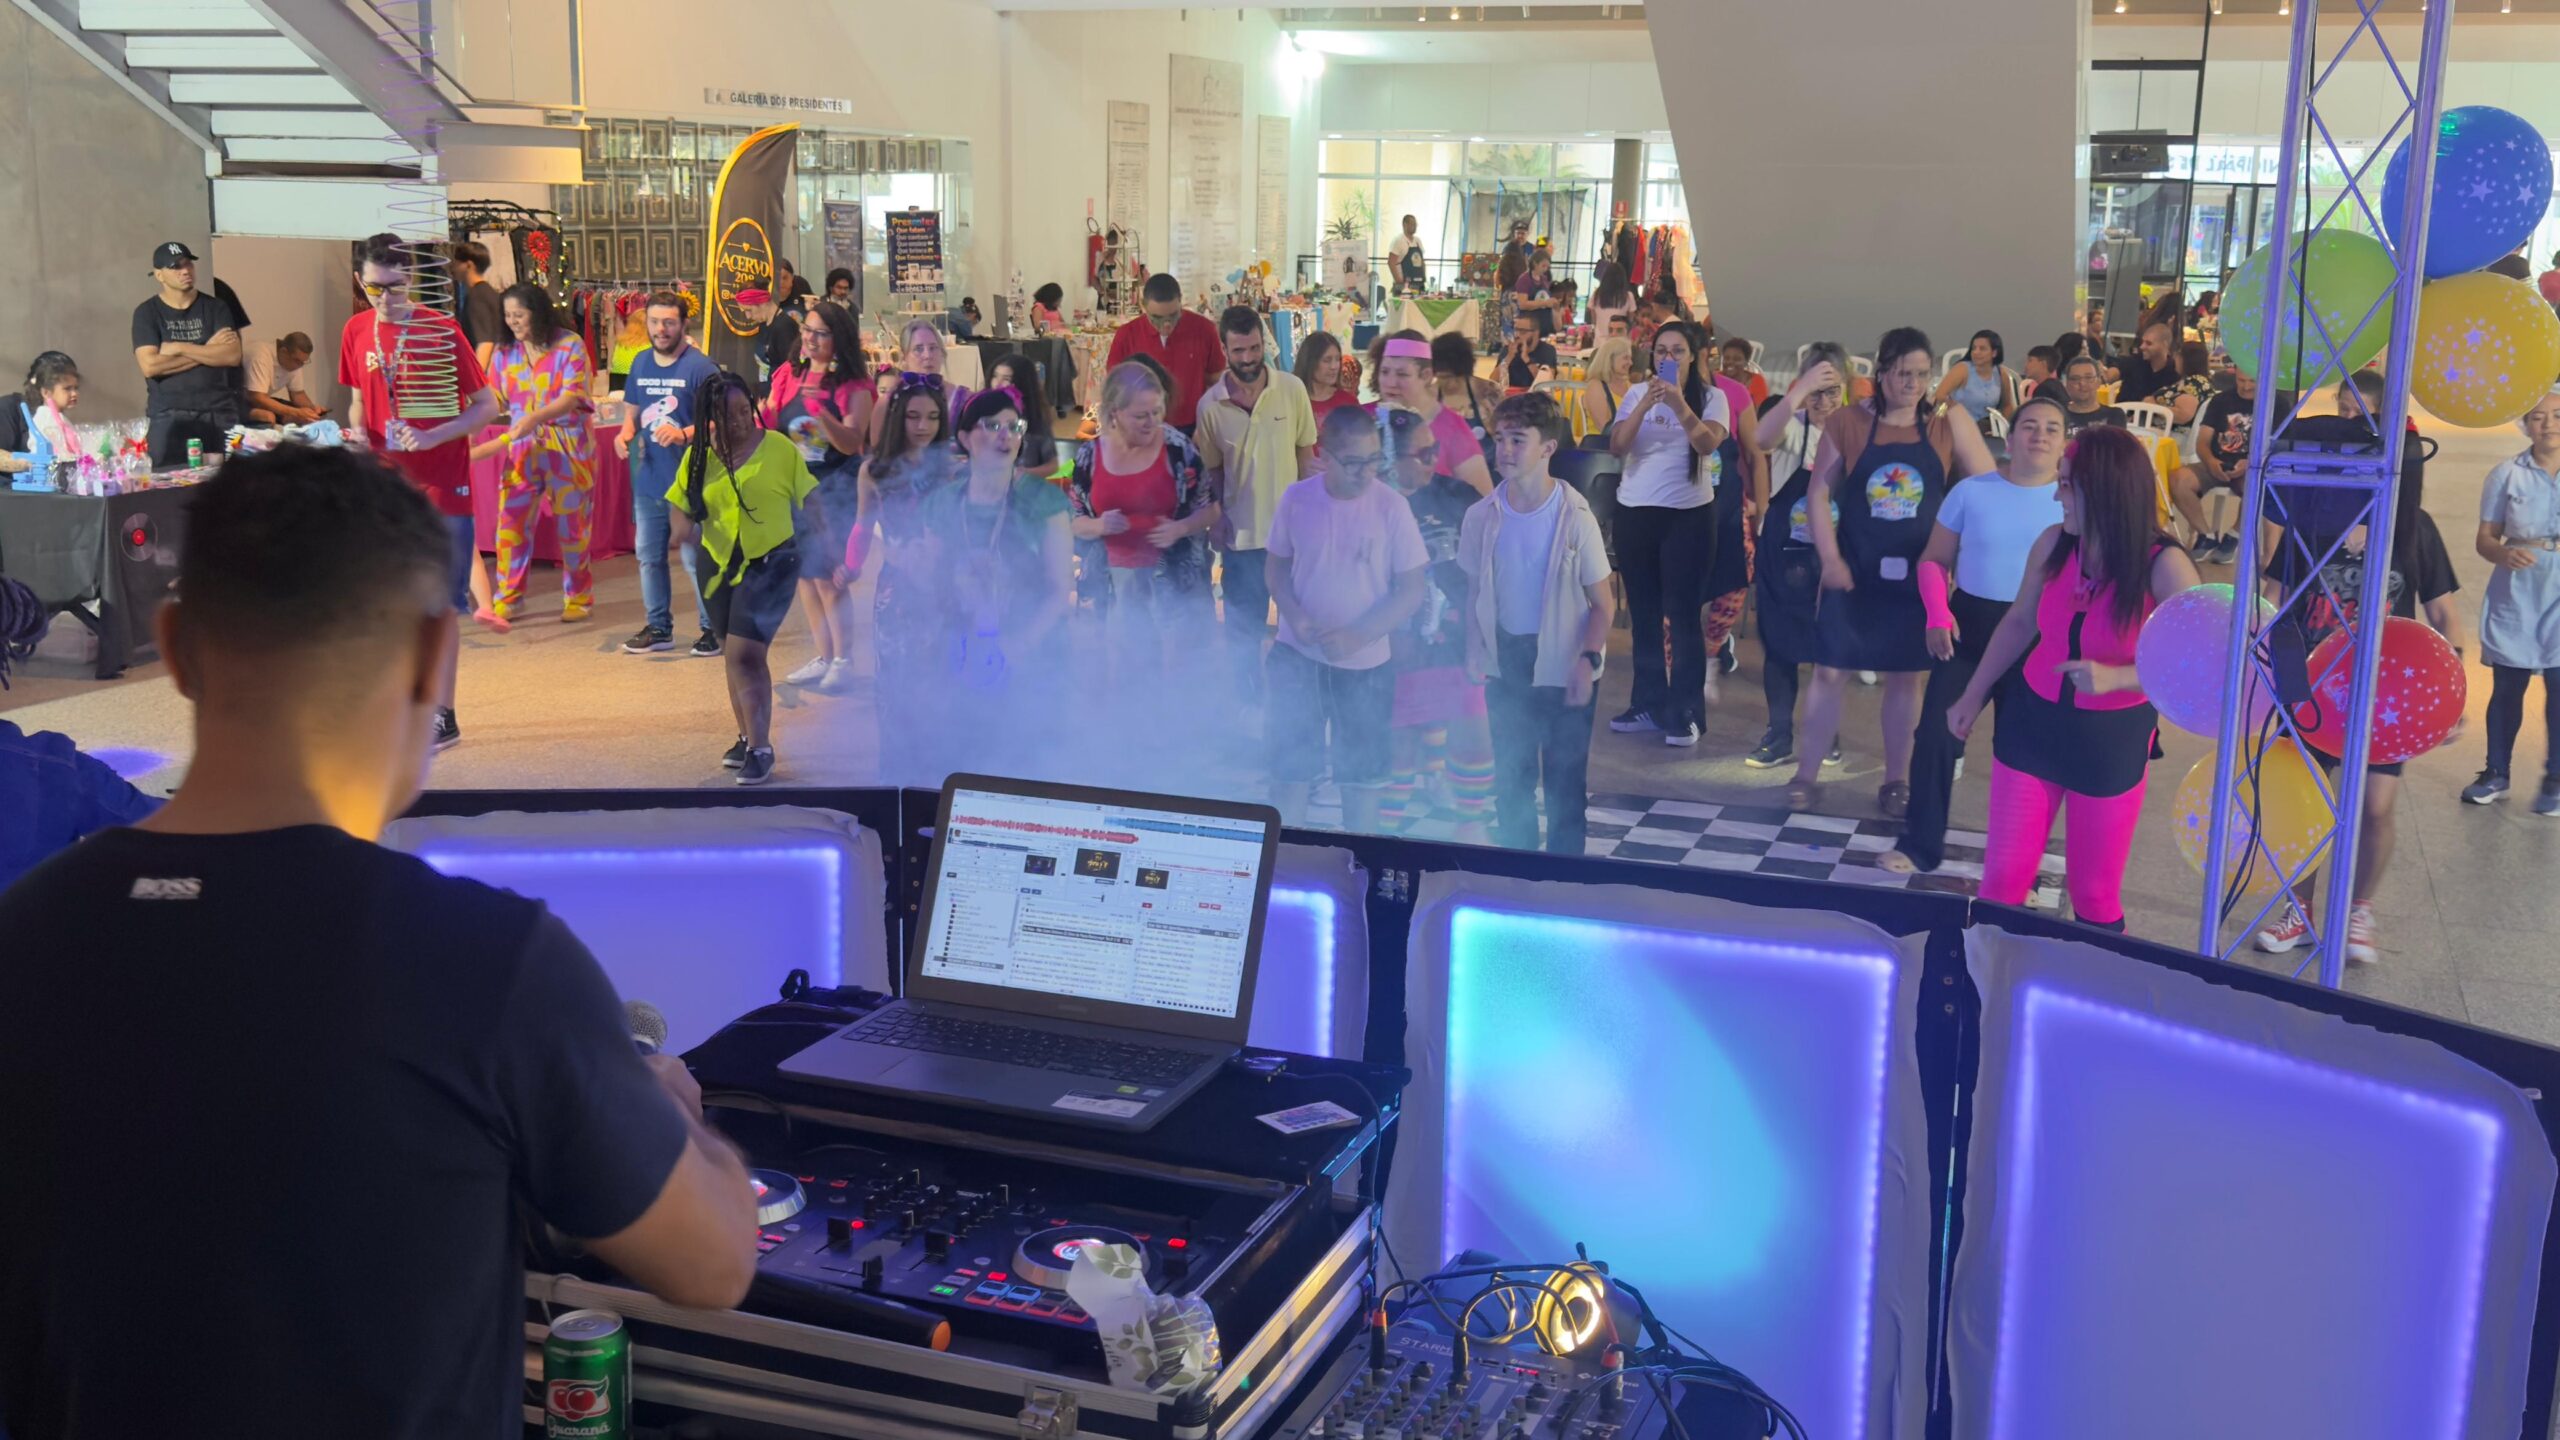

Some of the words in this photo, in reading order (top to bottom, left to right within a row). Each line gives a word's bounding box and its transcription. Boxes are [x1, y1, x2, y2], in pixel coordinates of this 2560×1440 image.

[730, 92, 768, 106] GALERIA
[770, 96, 786, 107] DOS
[789, 98, 843, 111] PRESIDENTES
[891, 217, 935, 226] Presentes
[719, 252, 770, 278] ACERVO
[637, 378, 660, 386] GOOD
[662, 378, 686, 387] VIBES
[546, 1415, 611, 1438] Guaraná
